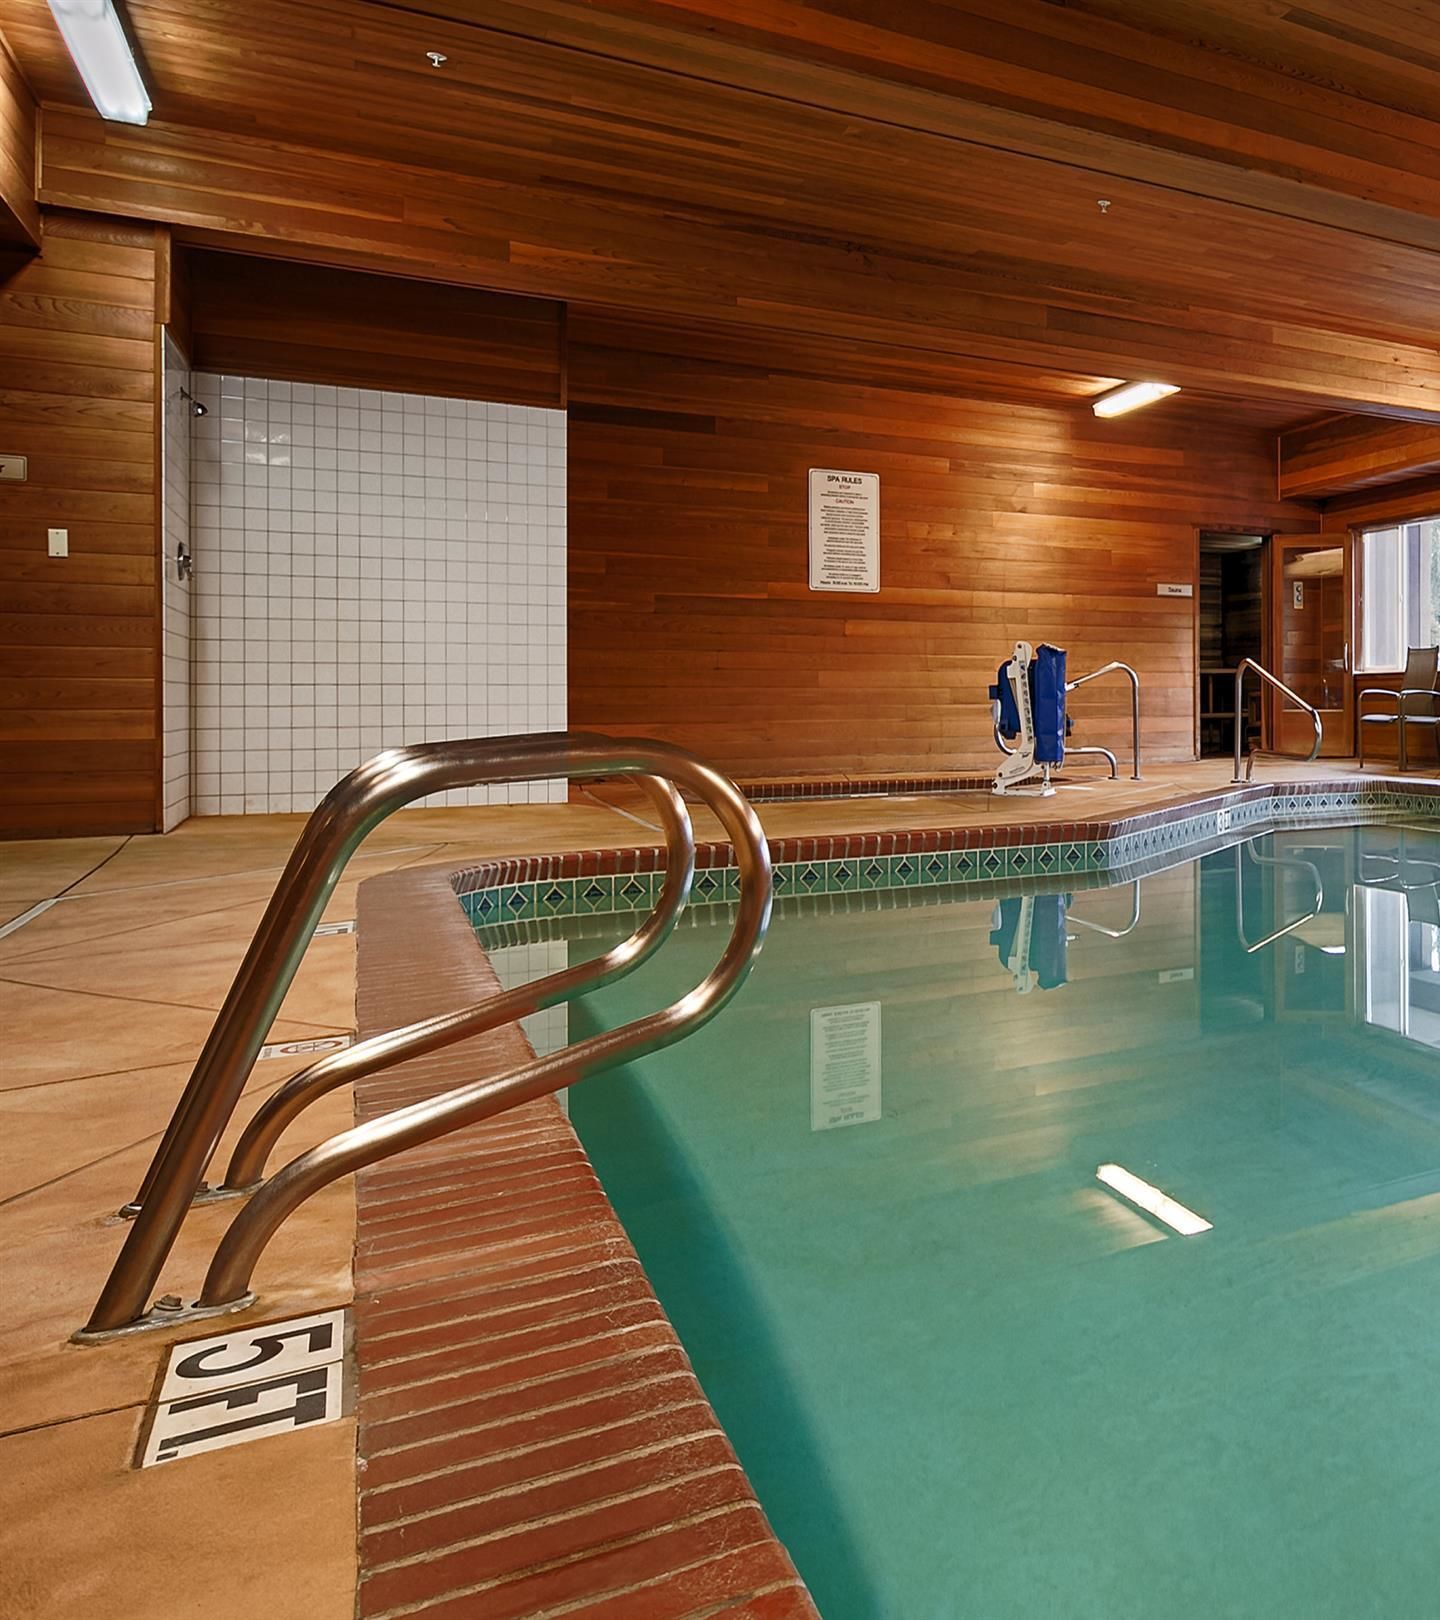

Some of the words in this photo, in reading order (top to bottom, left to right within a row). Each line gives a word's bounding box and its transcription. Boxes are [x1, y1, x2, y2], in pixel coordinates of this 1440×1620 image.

[827, 475, 840, 483] SPA
[841, 476, 863, 485] RULES
[175, 1322, 334, 1379] 5
